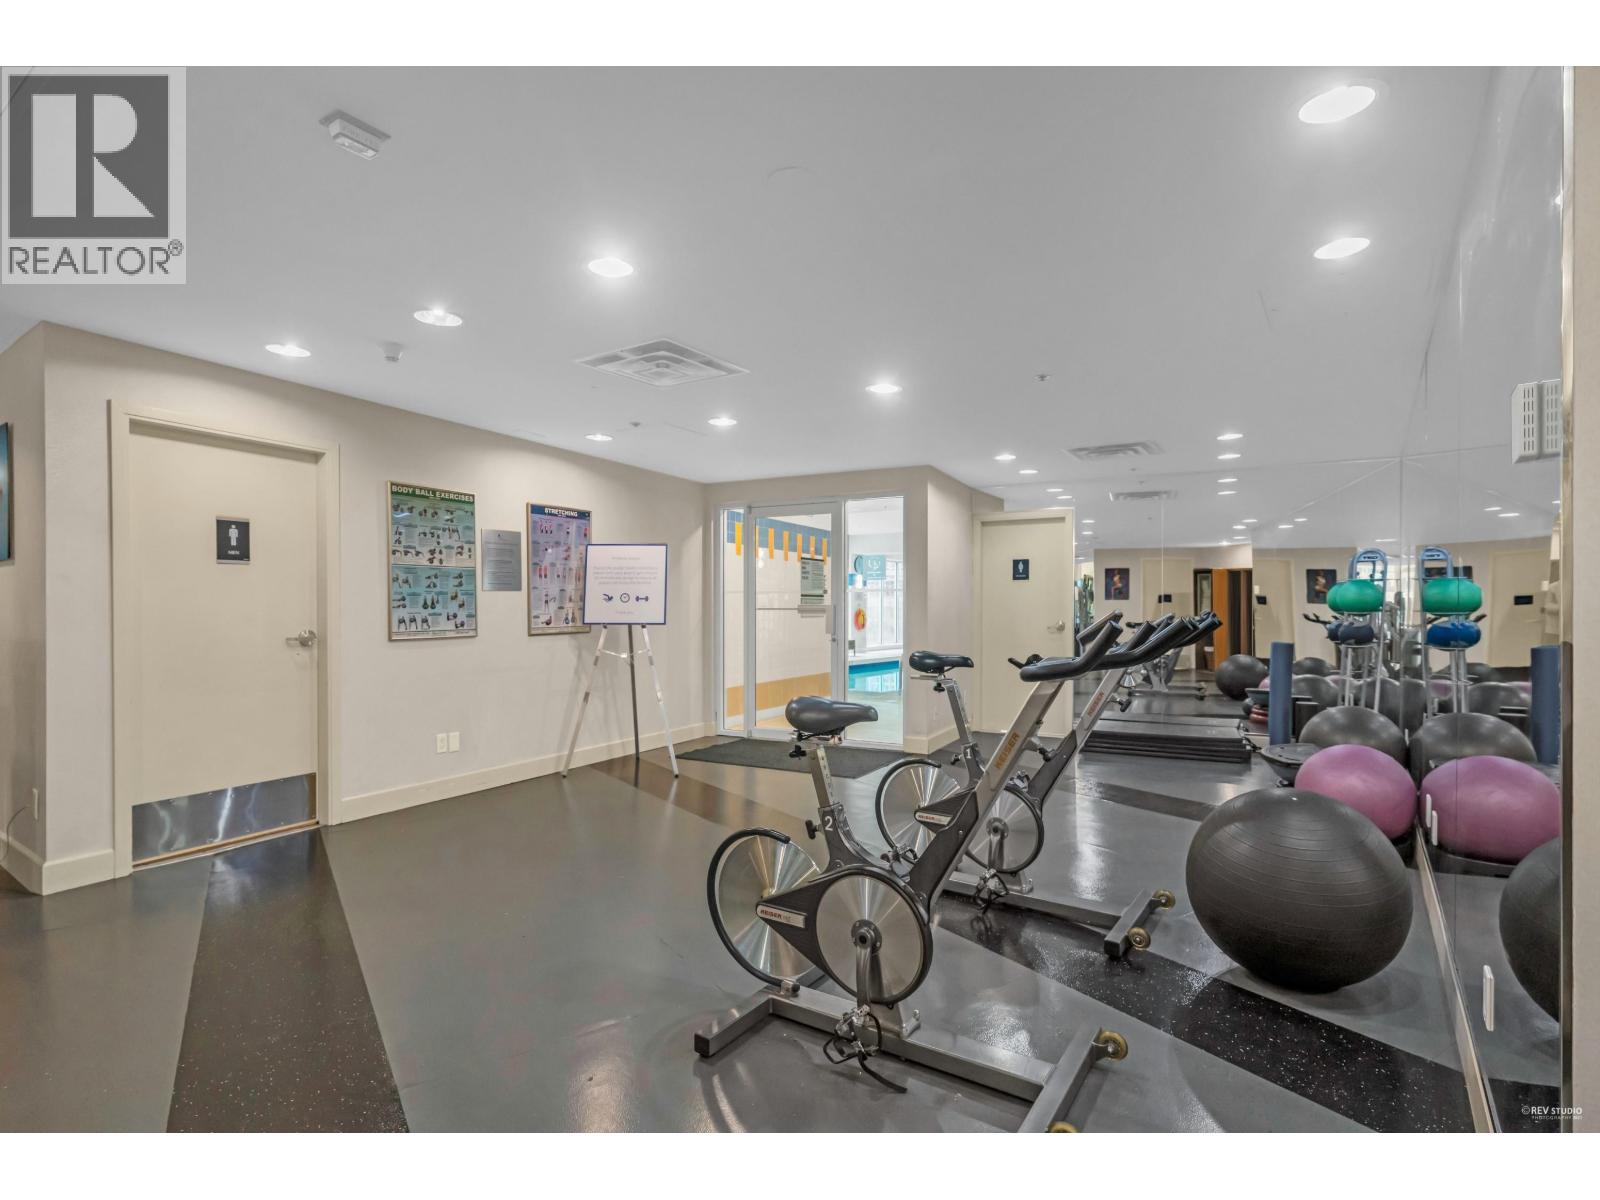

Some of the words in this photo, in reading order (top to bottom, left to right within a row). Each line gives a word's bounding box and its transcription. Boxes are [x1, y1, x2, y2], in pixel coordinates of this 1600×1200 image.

[392, 485, 413, 494] BODY
[415, 488, 434, 497] BALL
[436, 491, 474, 502] EXERCISES
[544, 507, 578, 517] STRETCHING
[965, 747, 972, 759] 1
[994, 731, 1020, 769] KEISER
[824, 815, 834, 832] 2
